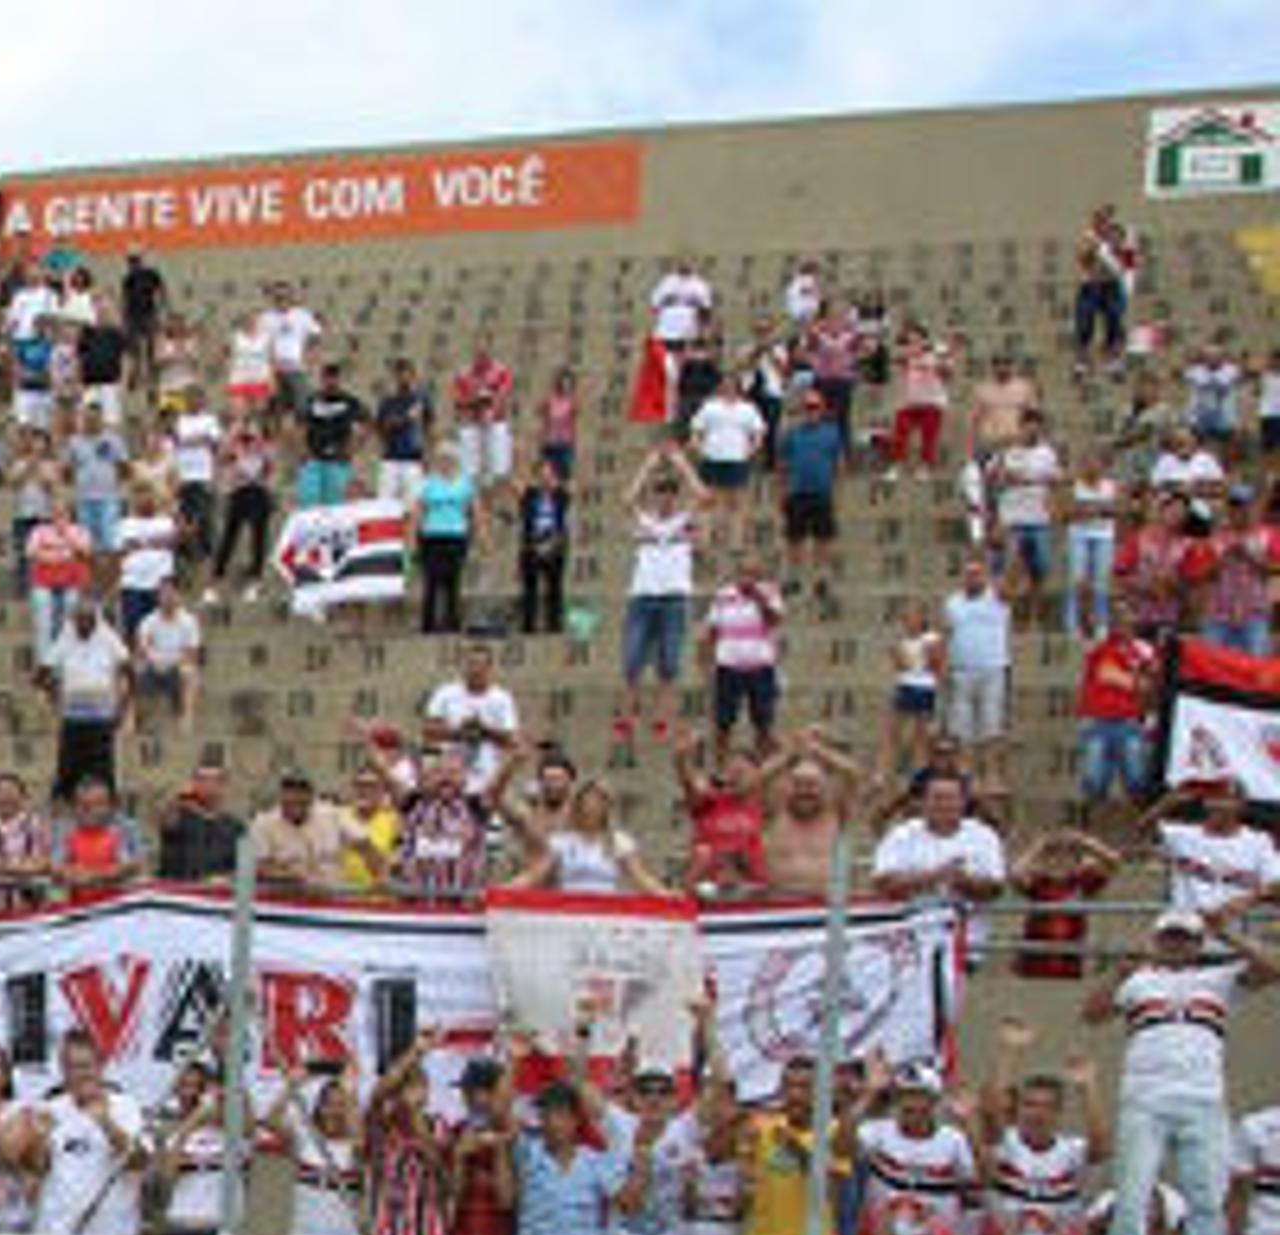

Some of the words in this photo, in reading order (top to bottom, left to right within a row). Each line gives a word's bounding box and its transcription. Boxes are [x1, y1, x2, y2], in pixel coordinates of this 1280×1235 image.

[5, 204, 32, 237] A
[43, 191, 176, 236] GENTE
[188, 180, 284, 225] VIVE
[302, 174, 405, 219] COM
[432, 154, 546, 207] VOCÊ
